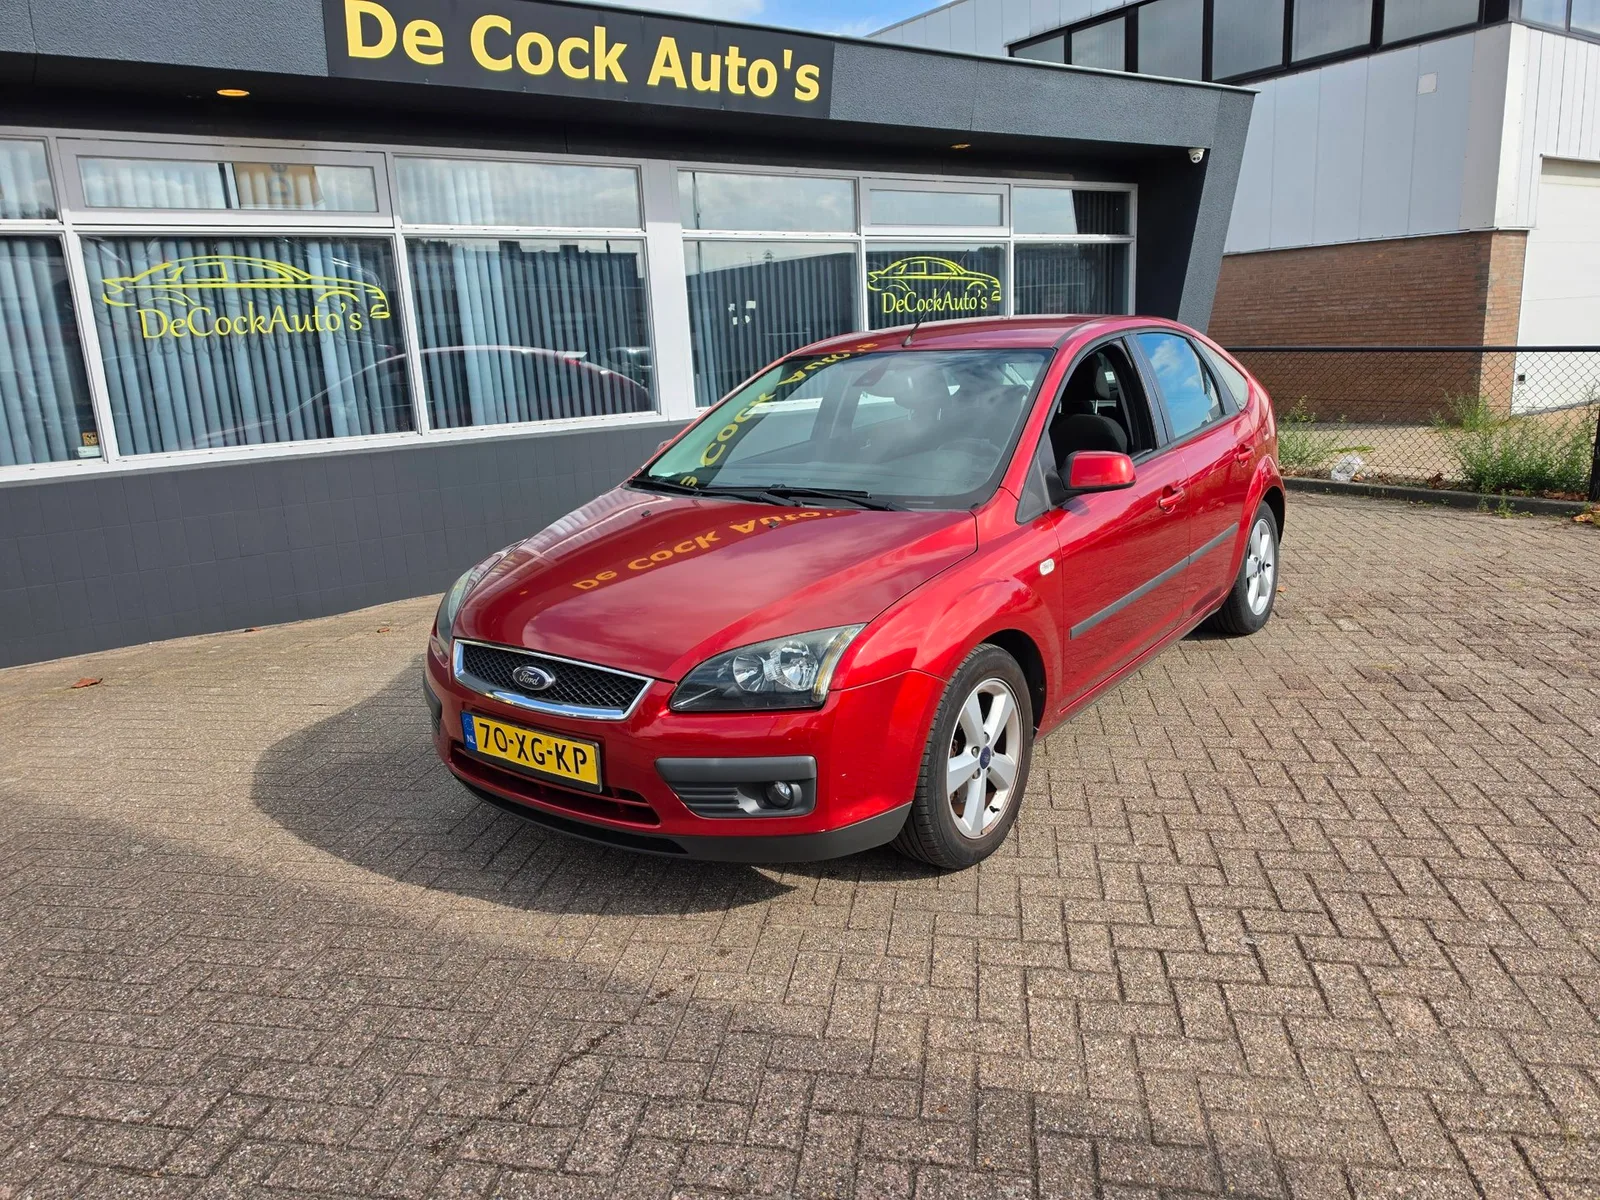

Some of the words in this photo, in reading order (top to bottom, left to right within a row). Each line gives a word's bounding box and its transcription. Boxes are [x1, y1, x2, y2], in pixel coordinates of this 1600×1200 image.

[345, 0, 444, 66] De
[471, 15, 627, 83] Cock
[649, 36, 819, 101] Auto's
[881, 288, 988, 313] DeCockAuto's
[136, 301, 363, 339] DeCockAuto's
[519, 671, 539, 686] Ford
[466, 733, 476, 745] NL
[480, 723, 587, 774] 70-XG-KP
